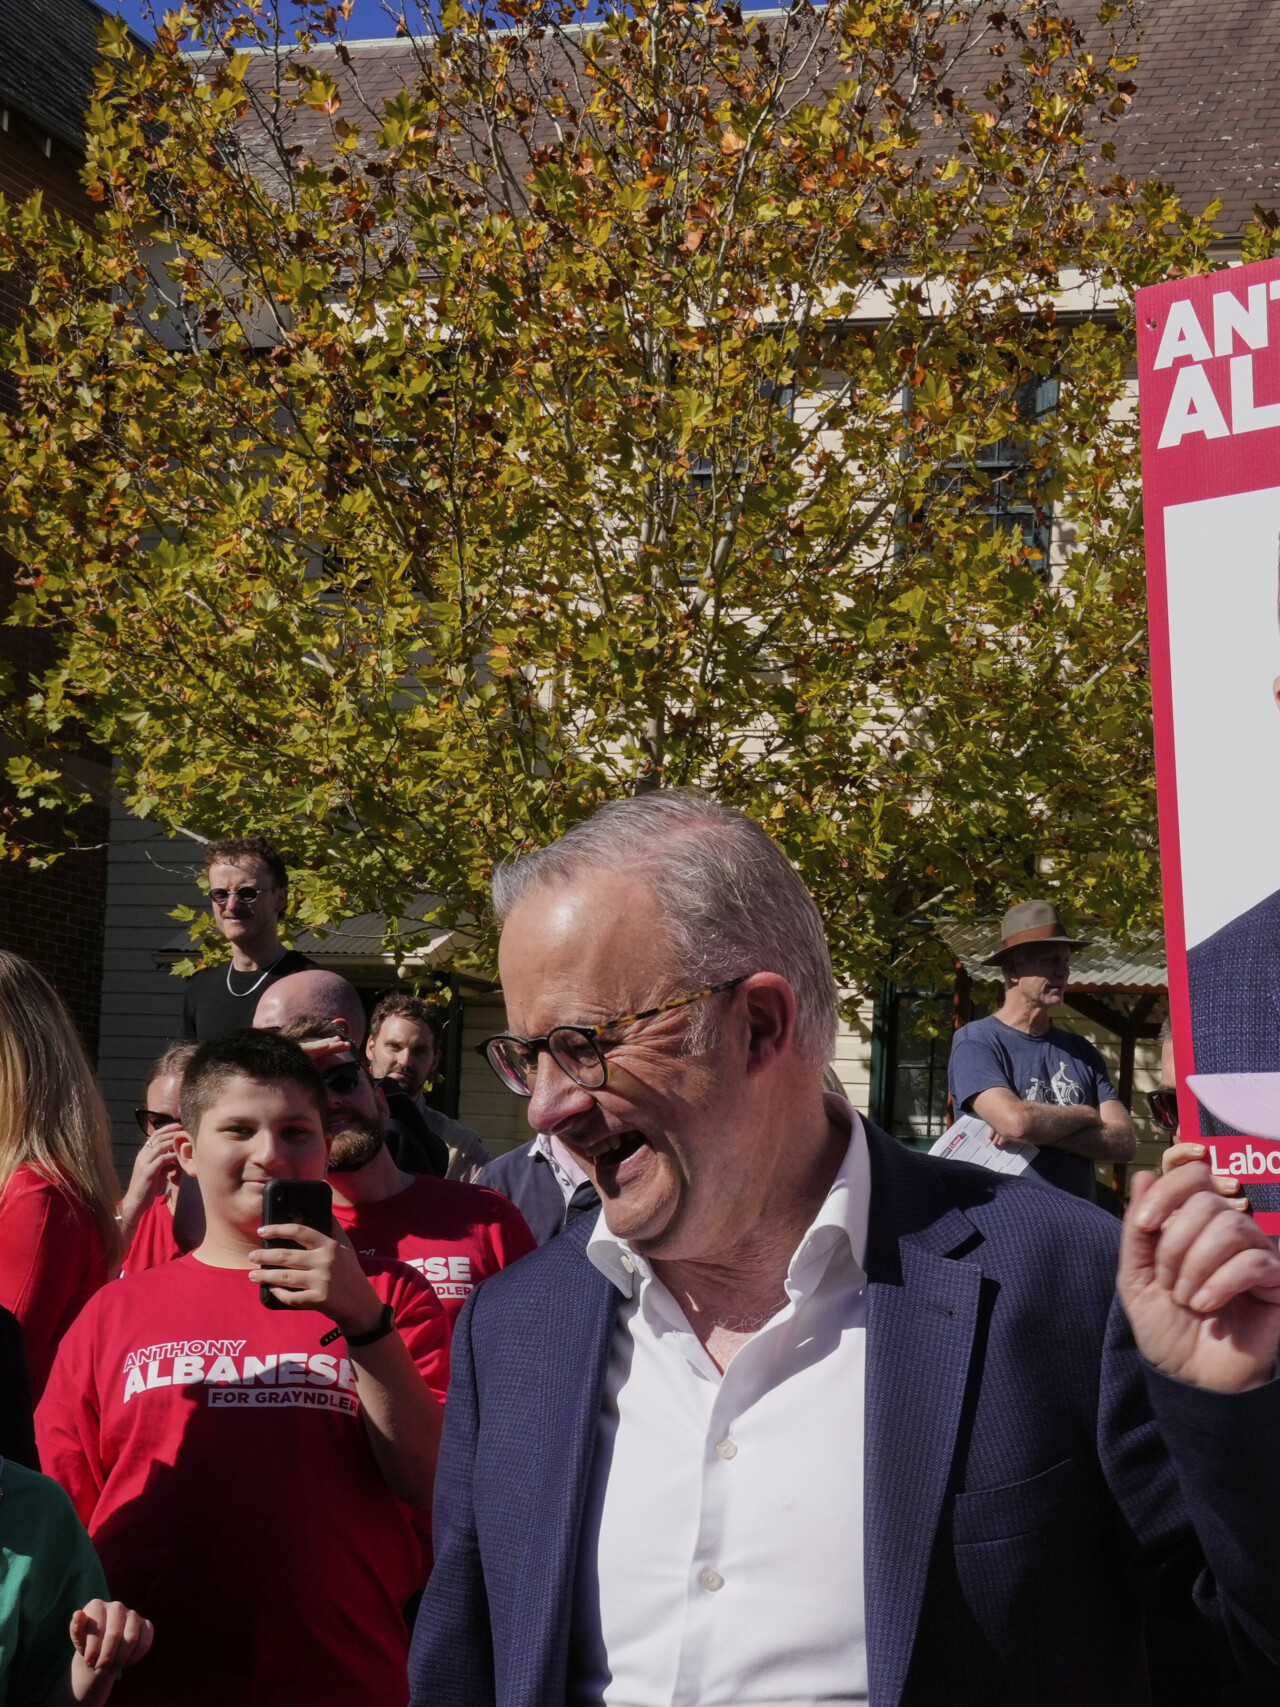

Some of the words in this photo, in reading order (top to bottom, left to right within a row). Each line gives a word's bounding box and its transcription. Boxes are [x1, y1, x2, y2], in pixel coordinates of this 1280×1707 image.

[123, 1340, 247, 1373] ANTHONY
[211, 1392, 250, 1404] FOR
[261, 1391, 358, 1413] GRAYNDLER
